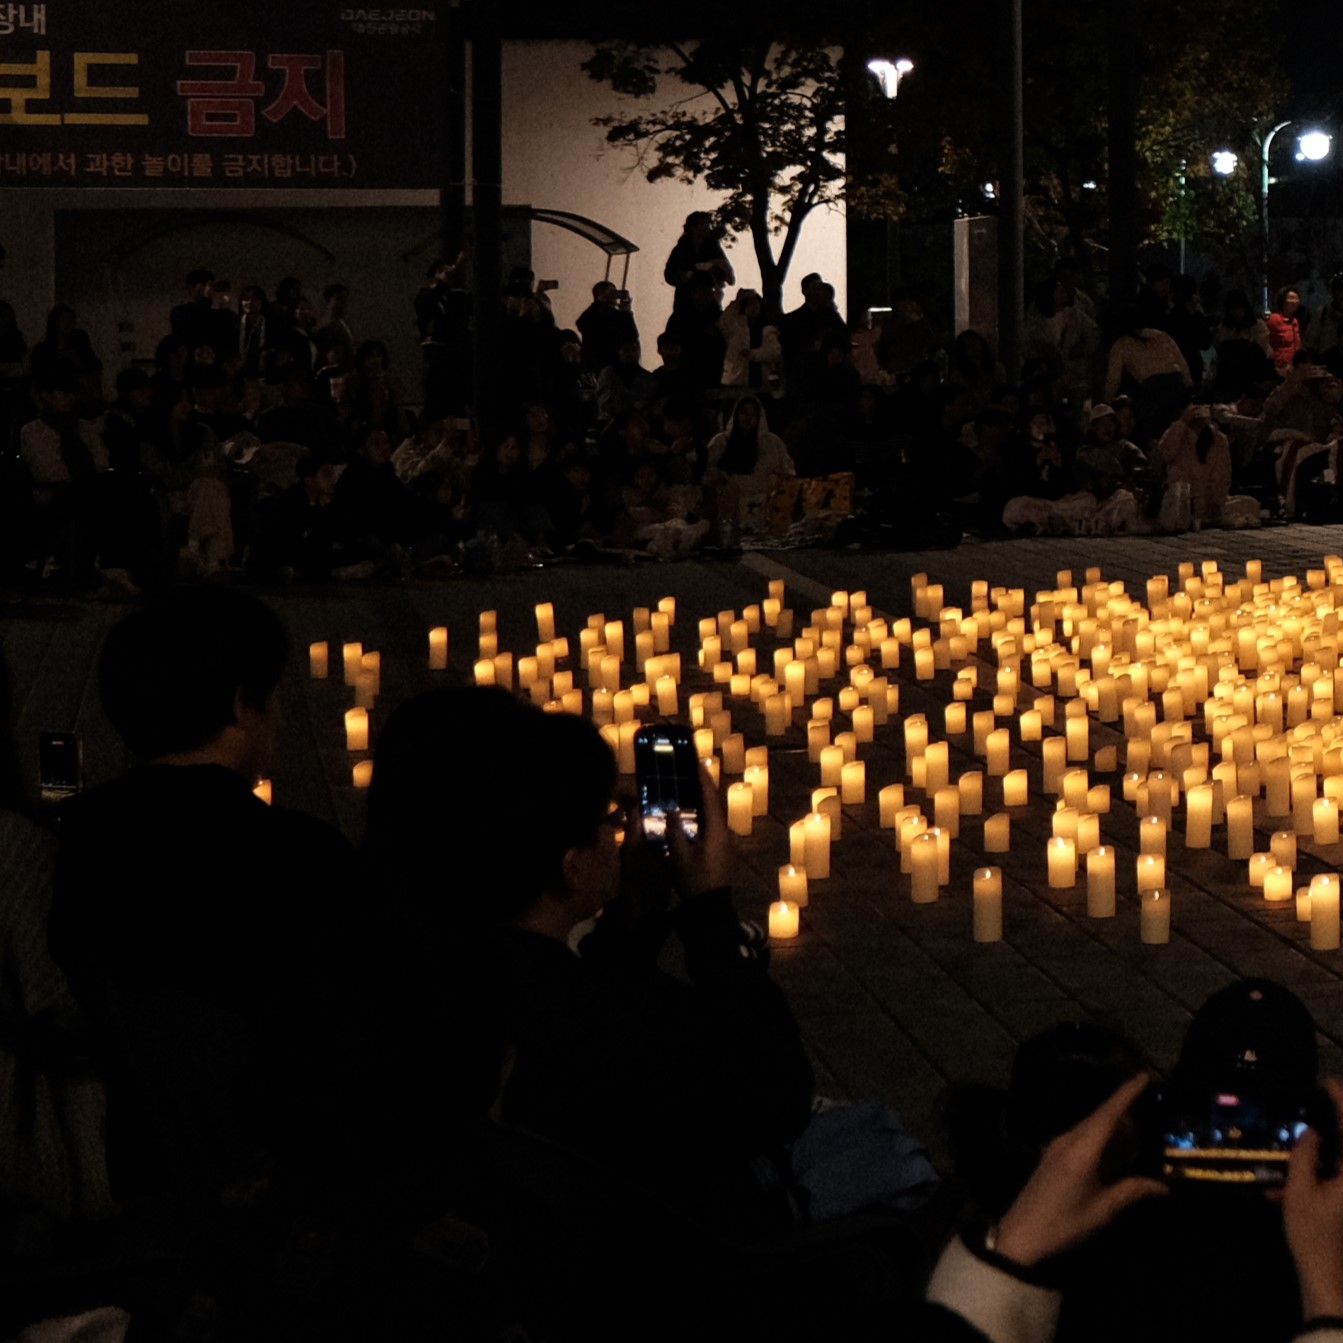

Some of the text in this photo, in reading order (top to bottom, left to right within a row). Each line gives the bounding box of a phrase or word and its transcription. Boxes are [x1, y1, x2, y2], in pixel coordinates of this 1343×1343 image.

[340, 8, 435, 22] DAEJEON
[176, 49, 346, 139] 금지
[0, 152, 358, 178] 내에서 과한 놀이를 금지합니다.)
